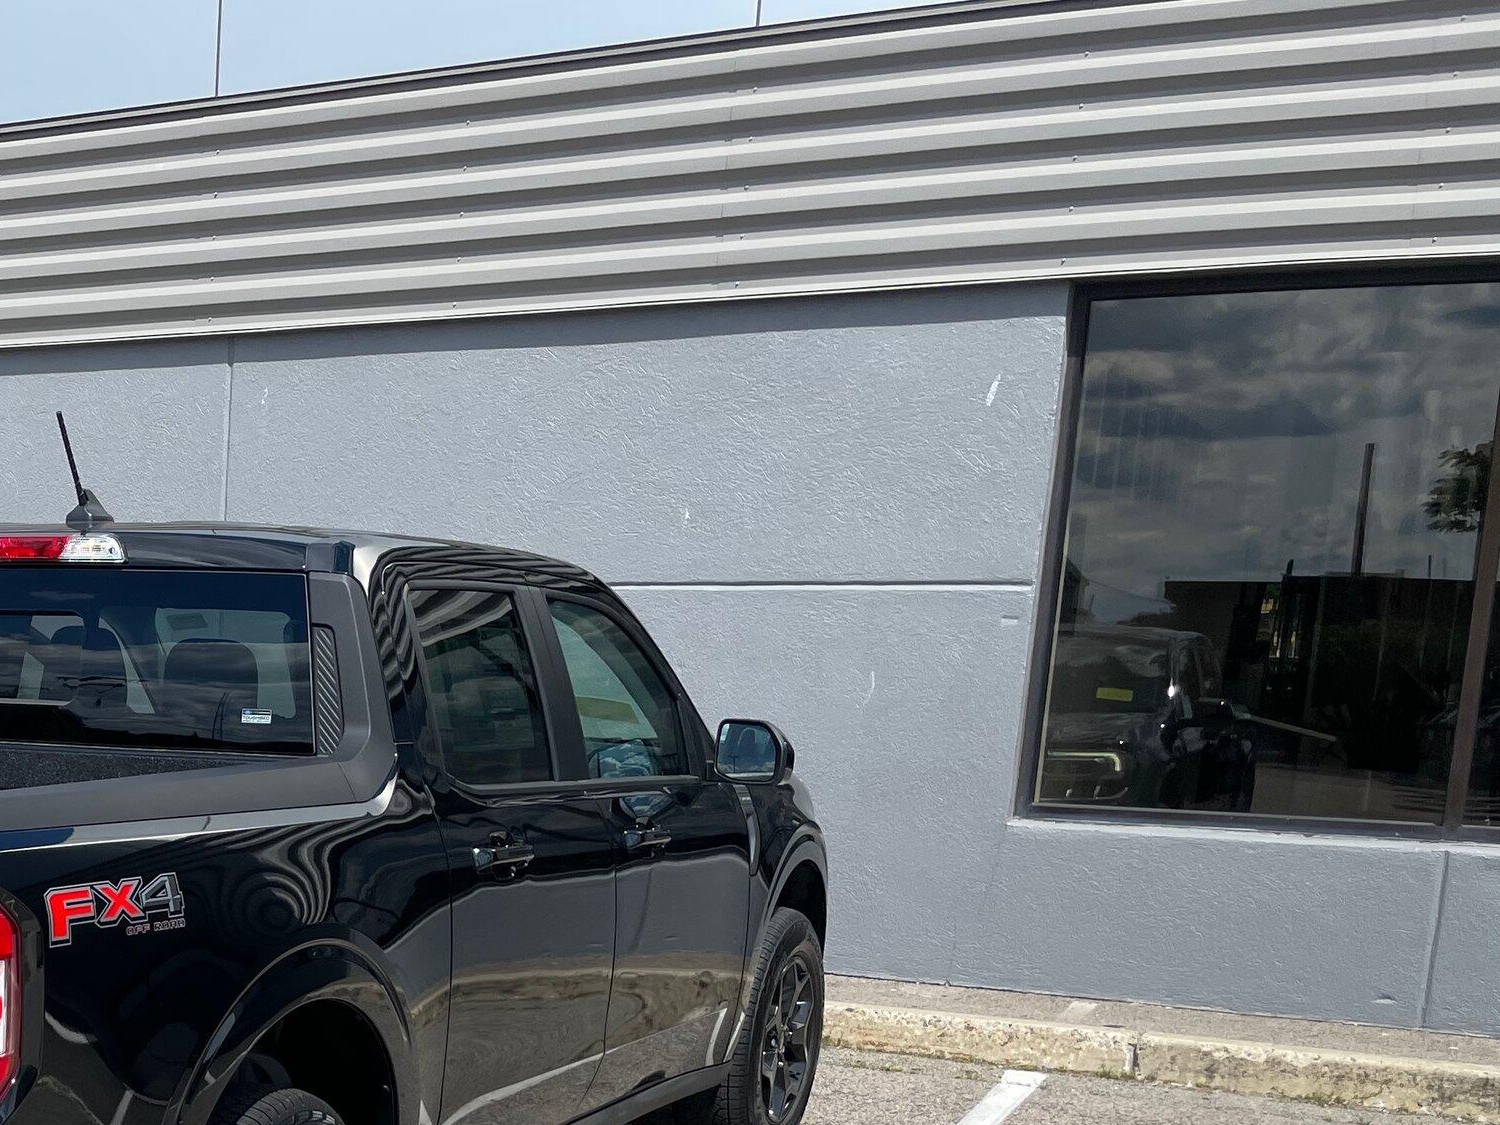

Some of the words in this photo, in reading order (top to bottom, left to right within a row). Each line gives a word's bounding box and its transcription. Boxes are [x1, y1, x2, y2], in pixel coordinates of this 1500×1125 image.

[43, 871, 185, 948] FX4
[126, 922, 151, 936] OFF
[153, 918, 186, 932] ROAD
